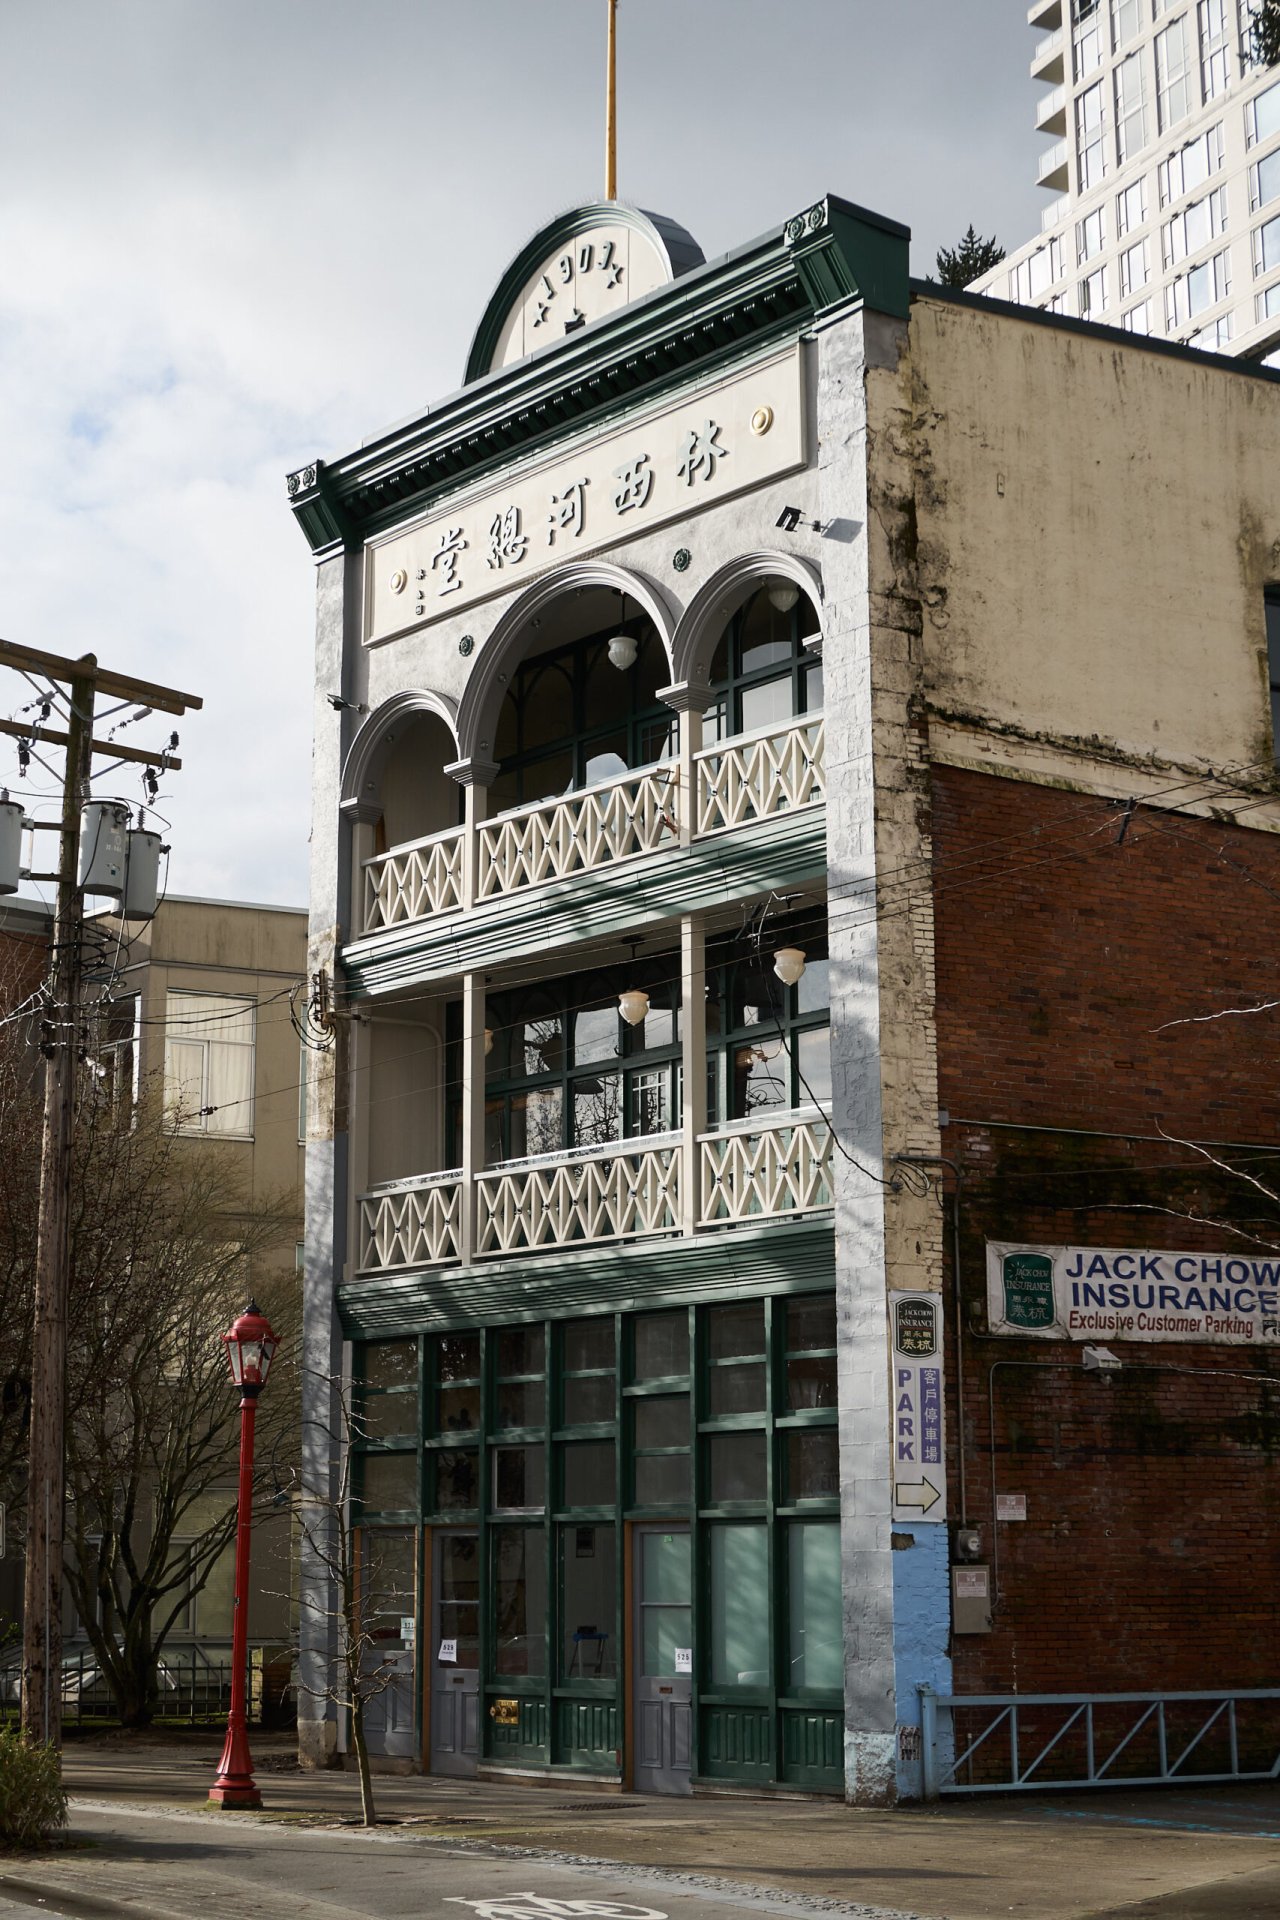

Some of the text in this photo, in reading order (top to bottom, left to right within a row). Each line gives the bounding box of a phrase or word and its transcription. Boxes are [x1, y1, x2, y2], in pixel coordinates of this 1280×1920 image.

[1006, 1280, 1051, 1292] INSURANCE
[1015, 1268, 1049, 1278] JACK CHOW
[1066, 1254, 1280, 1287] JACK CHOW
[1071, 1282, 1278, 1315] INSURANCE
[900, 1319, 934, 1328] INSURANCE
[1069, 1310, 1254, 1339] Exclusive Customer Parking
[897, 1369, 915, 1461] PARK
[924, 1369, 938, 1462] 客戶停車場
